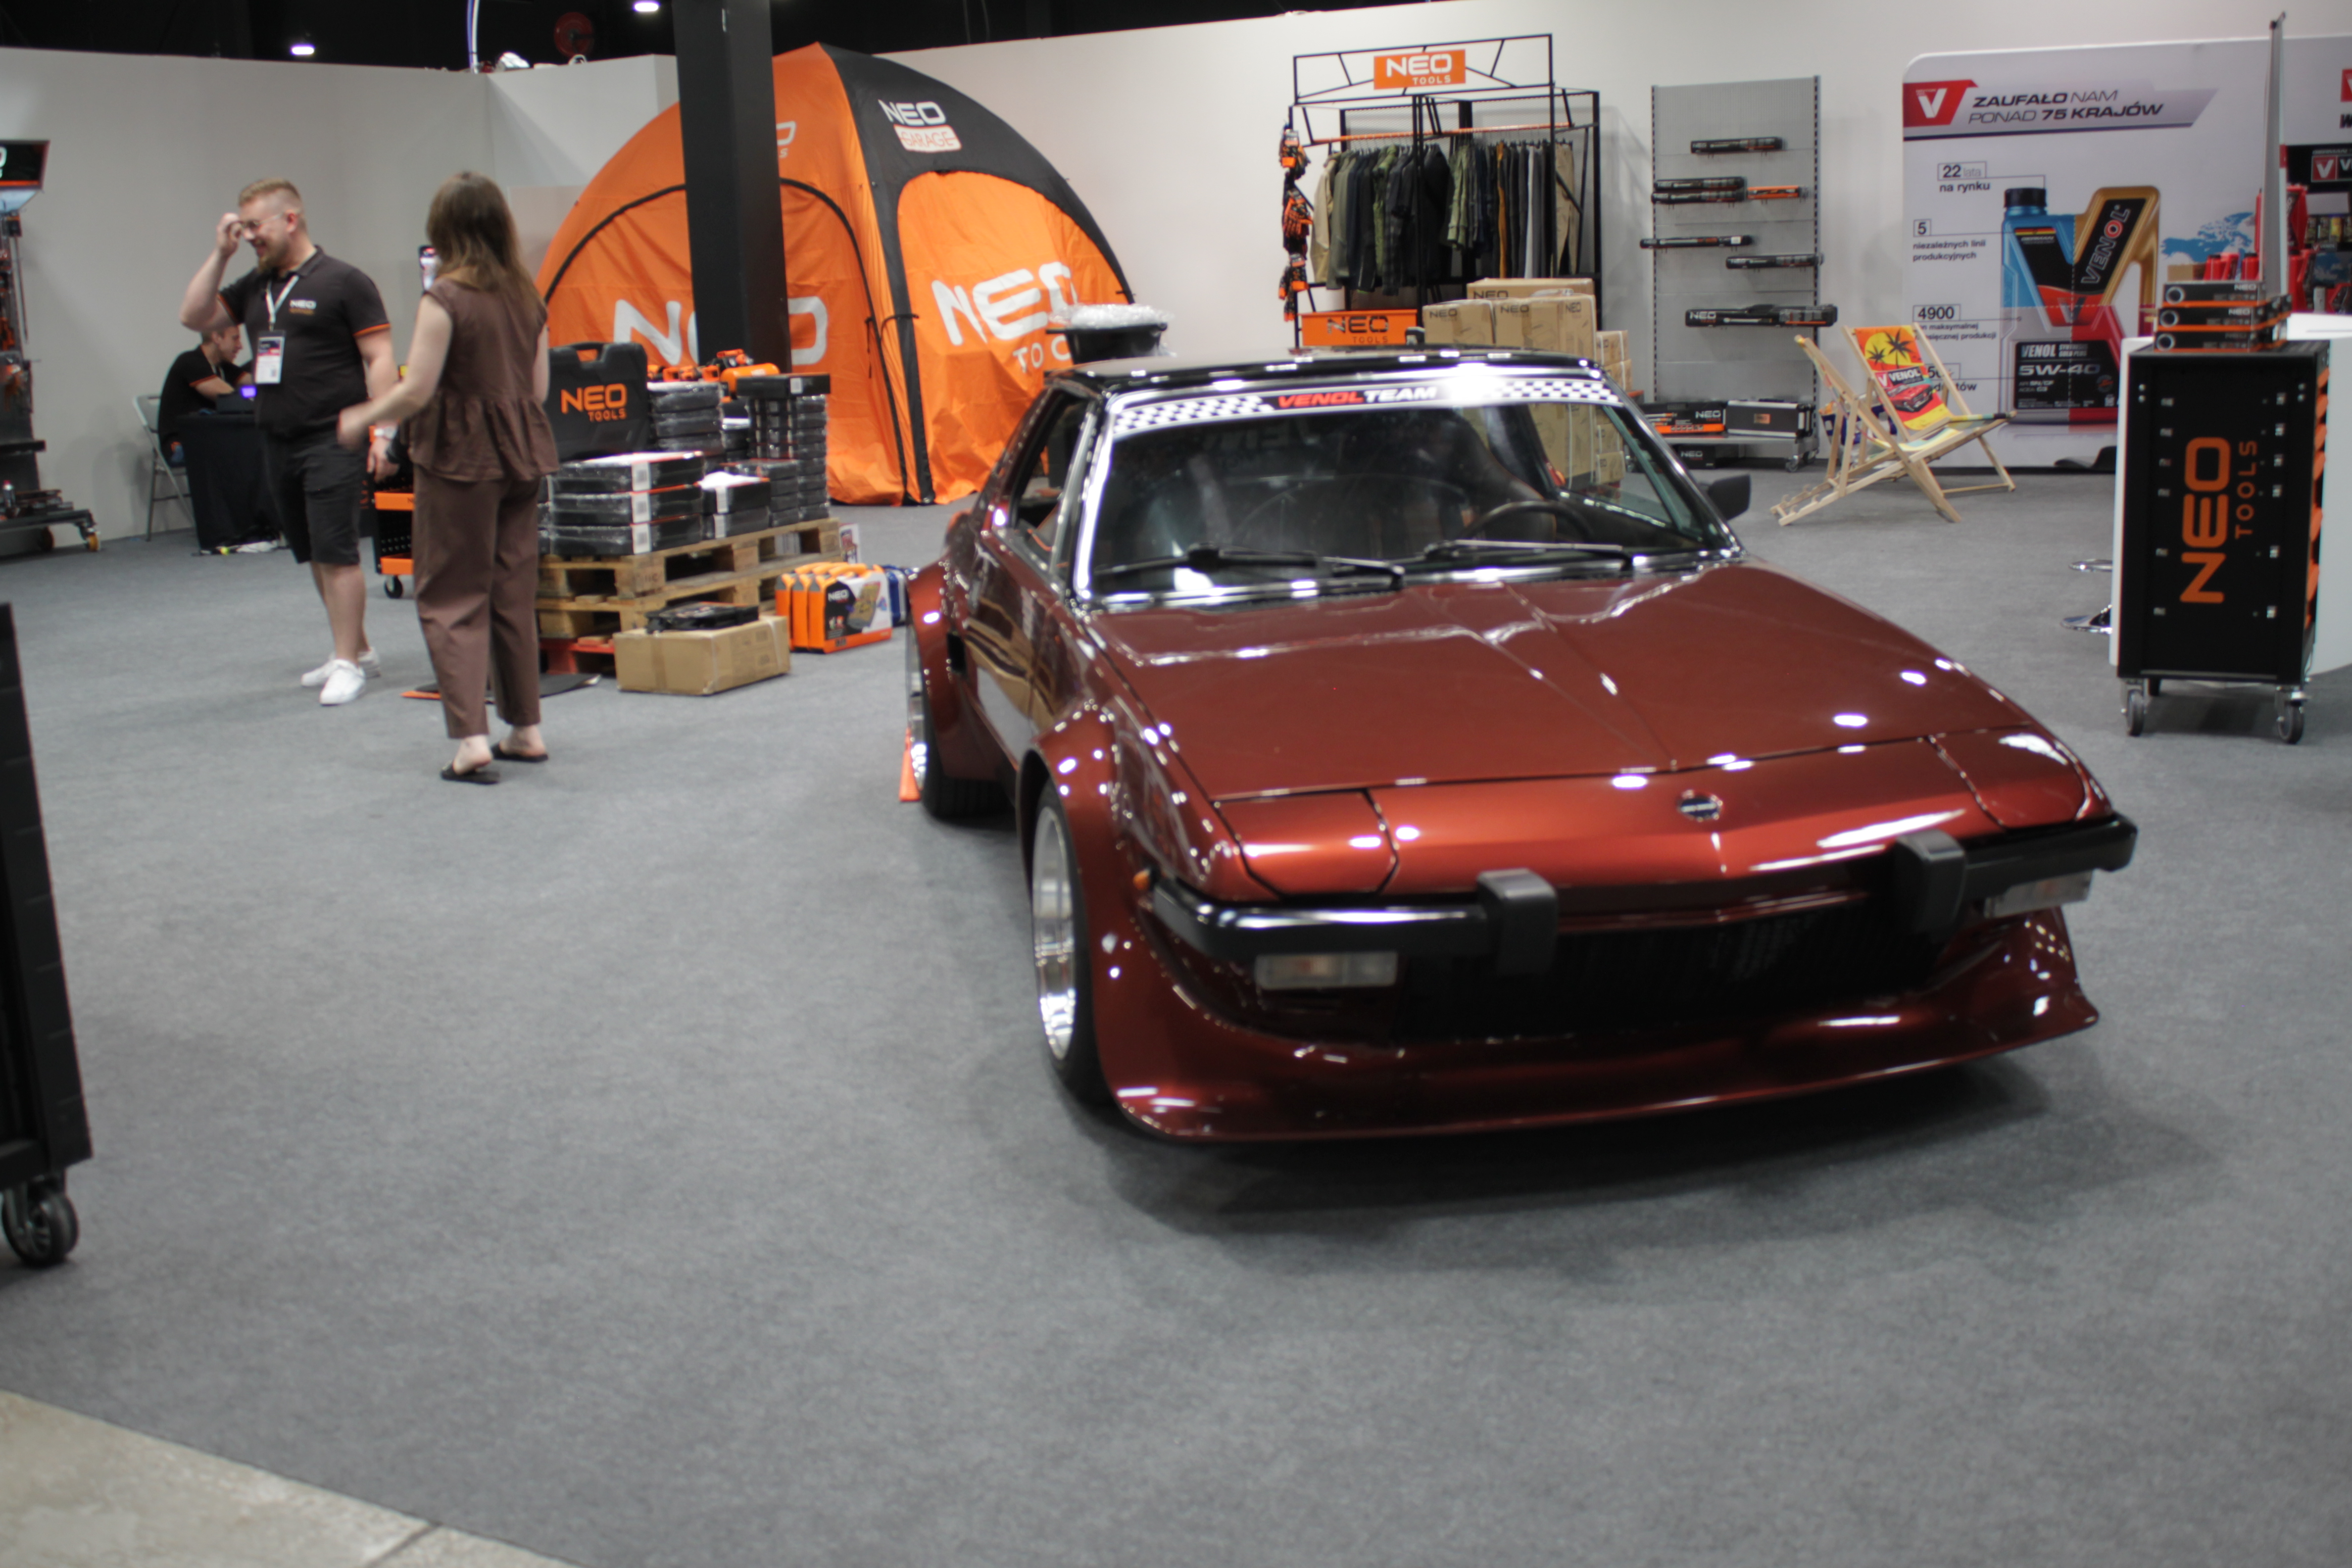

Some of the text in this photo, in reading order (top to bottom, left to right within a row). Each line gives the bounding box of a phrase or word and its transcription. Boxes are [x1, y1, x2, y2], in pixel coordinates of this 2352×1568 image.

[1386, 53, 1452, 77] NEO
[1413, 75, 1451, 85] TOOLS
[1972, 90, 2118, 108] ZAUFAŁO NAM
[878, 98, 947, 127] NEO
[1968, 102, 2164, 124] PONAD 75 KRAJÓW
[900, 131, 956, 147] GARAGE
[1942, 164, 1982, 178] 22 lata
[1939, 181, 1991, 194] na rynku
[1917, 222, 1927, 235] 5
[2080, 208, 2131, 284] VENOL
[1912, 251, 1977, 262] produkcyjnych
[1472, 290, 1509, 299] NEO
[289, 299, 317, 310] NEO
[1500, 304, 1530, 314] NEO
[1429, 308, 1458, 318] NEO
[1689, 311, 1716, 320] NEO
[1917, 306, 1955, 320] 4900
[613, 295, 828, 366] NO
[1327, 315, 1389, 334] NEO
[1013, 335, 1072, 374] TOO
[2021, 343, 2057, 358] VENOL
[1888, 368, 1922, 382] VENOL
[2017, 364, 2101, 376] 5W-40
[560, 383, 628, 415] NEO
[1277, 386, 1437, 409] VENOL TEAM
[587, 407, 627, 423] TOOLS
[1695, 410, 1721, 419] NEO
[2179, 436, 2258, 604] NEO TOOLS
[828, 589, 849, 602] NEO
